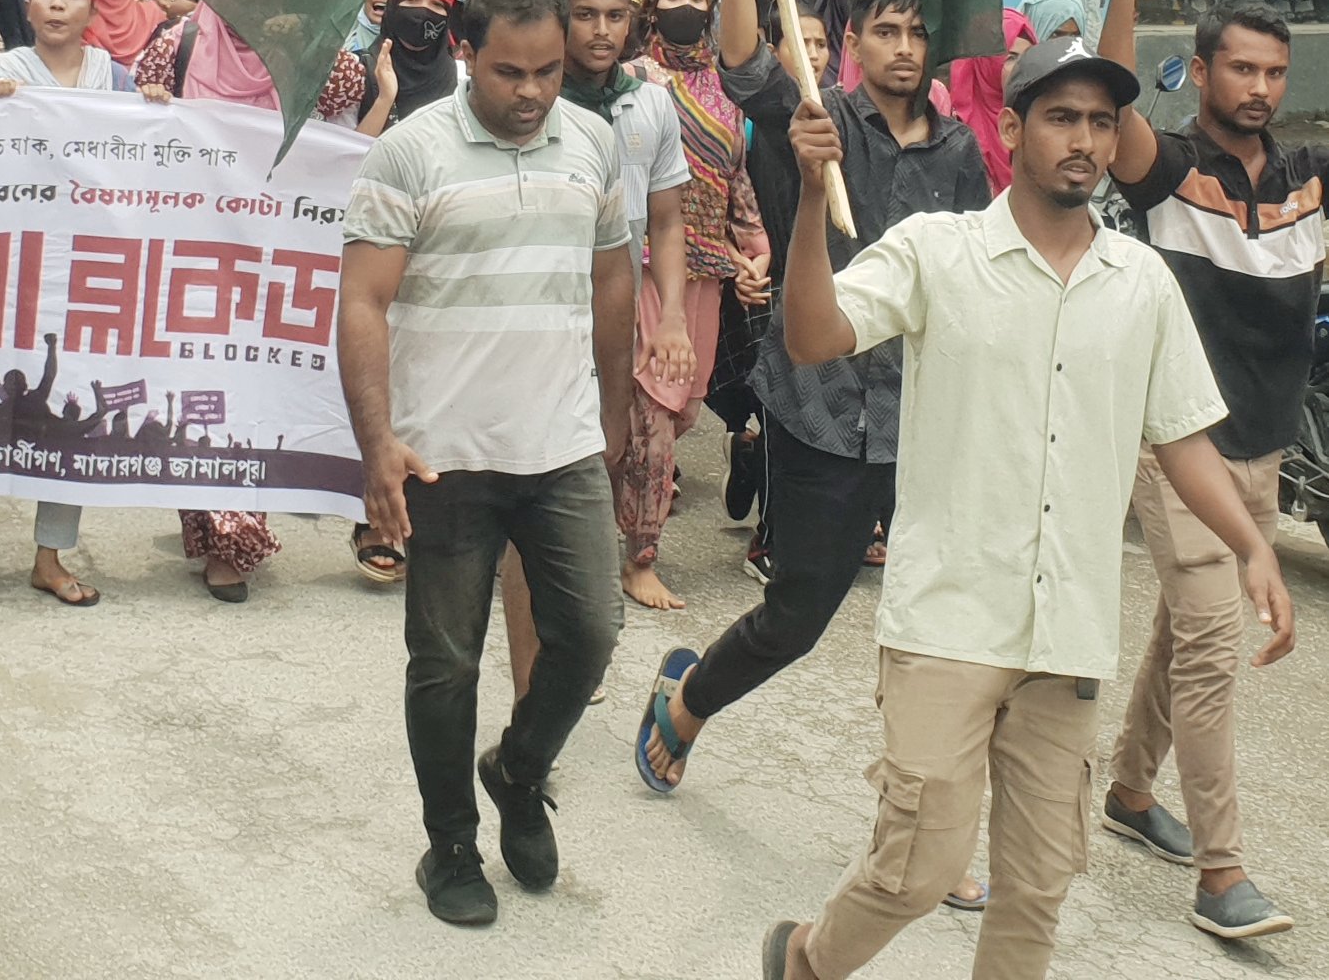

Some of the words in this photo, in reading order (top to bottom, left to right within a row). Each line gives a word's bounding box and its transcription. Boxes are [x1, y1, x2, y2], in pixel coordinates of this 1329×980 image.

[10, 136, 54, 160] যাক,
[63, 135, 147, 161] মেধাবীরা
[199, 147, 238, 168] পাক
[215, 193, 283, 217] কোটা
[293, 195, 346, 225] নির
[73, 452, 163, 477] মাদারগঞ্জ
